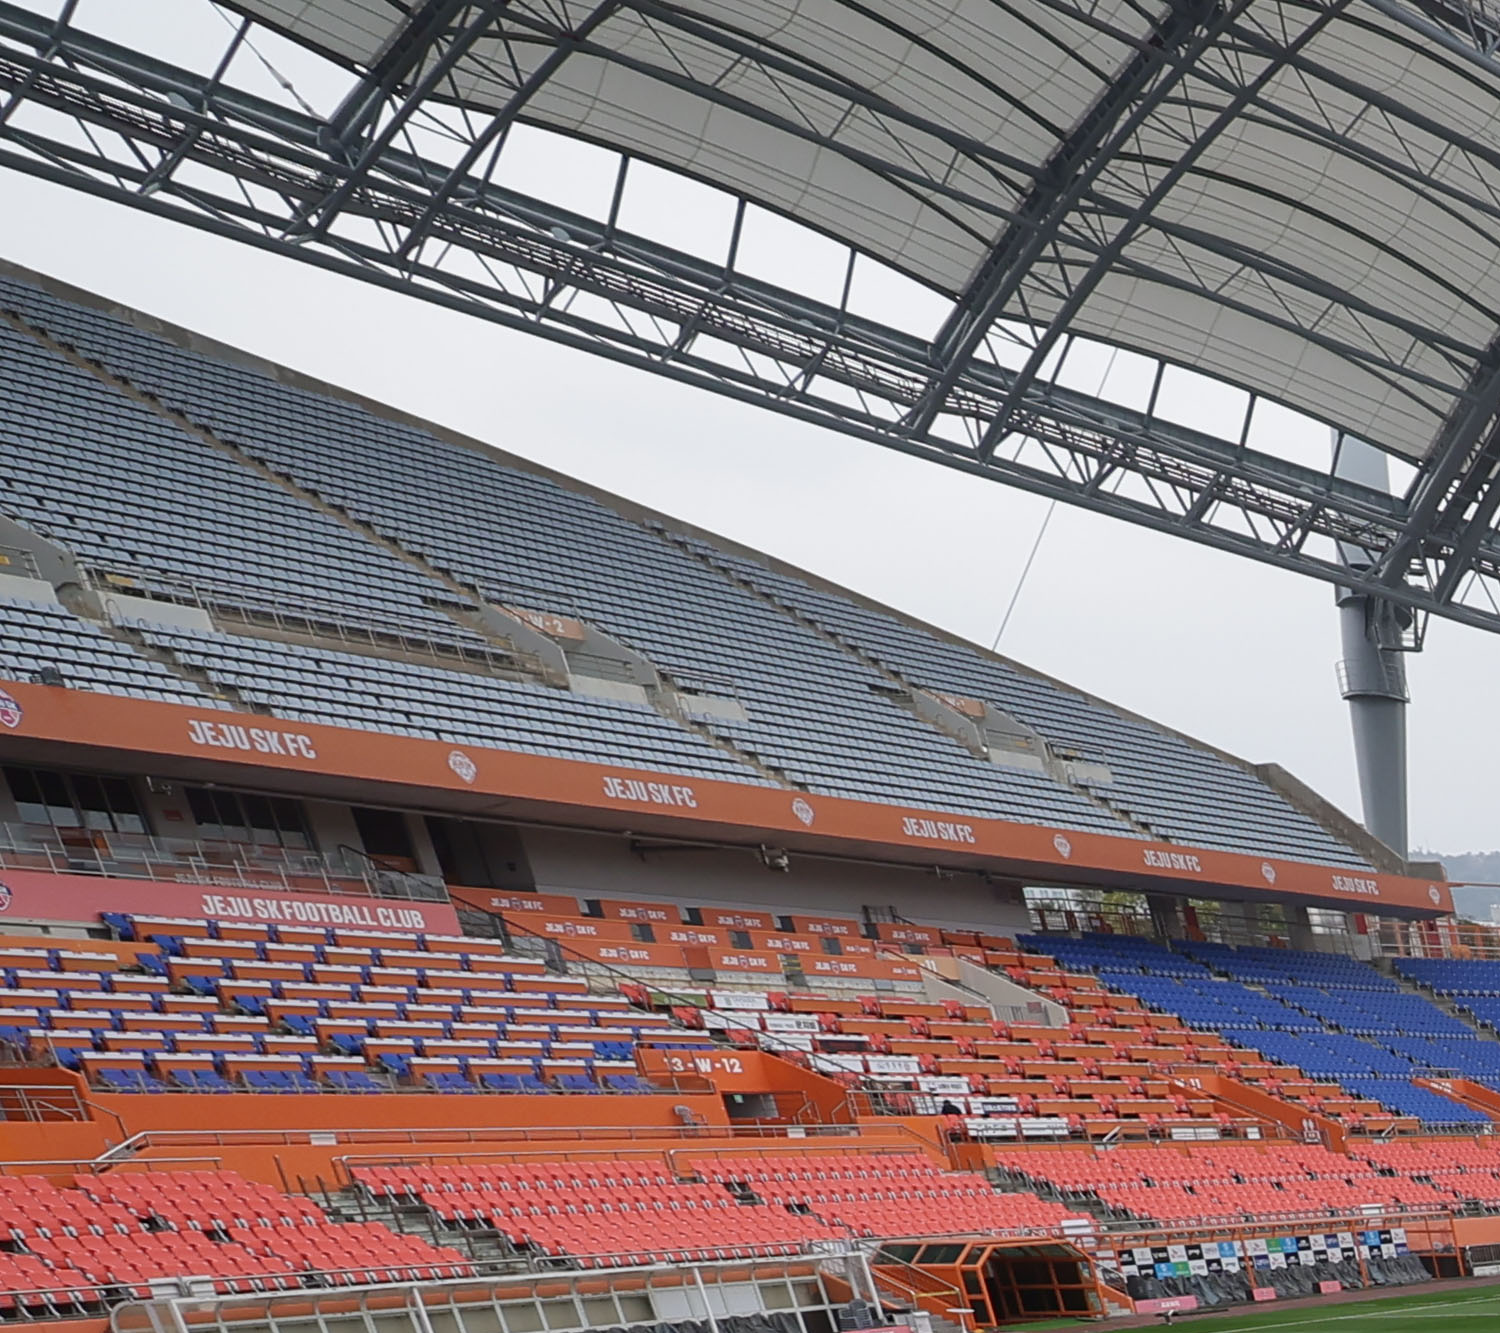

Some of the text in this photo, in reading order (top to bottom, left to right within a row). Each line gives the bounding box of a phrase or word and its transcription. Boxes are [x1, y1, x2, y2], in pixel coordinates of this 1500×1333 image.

[187, 719, 317, 759] JEJU SK FC
[603, 776, 697, 808] JEJU SK FC
[902, 817, 976, 844] JEJU SK FC
[1143, 849, 1201, 872] JEJU SK FC
[1332, 875, 1379, 896] JEJU SK FC
[202, 894, 425, 930] JEJU SK FOOTBALL CLUB
